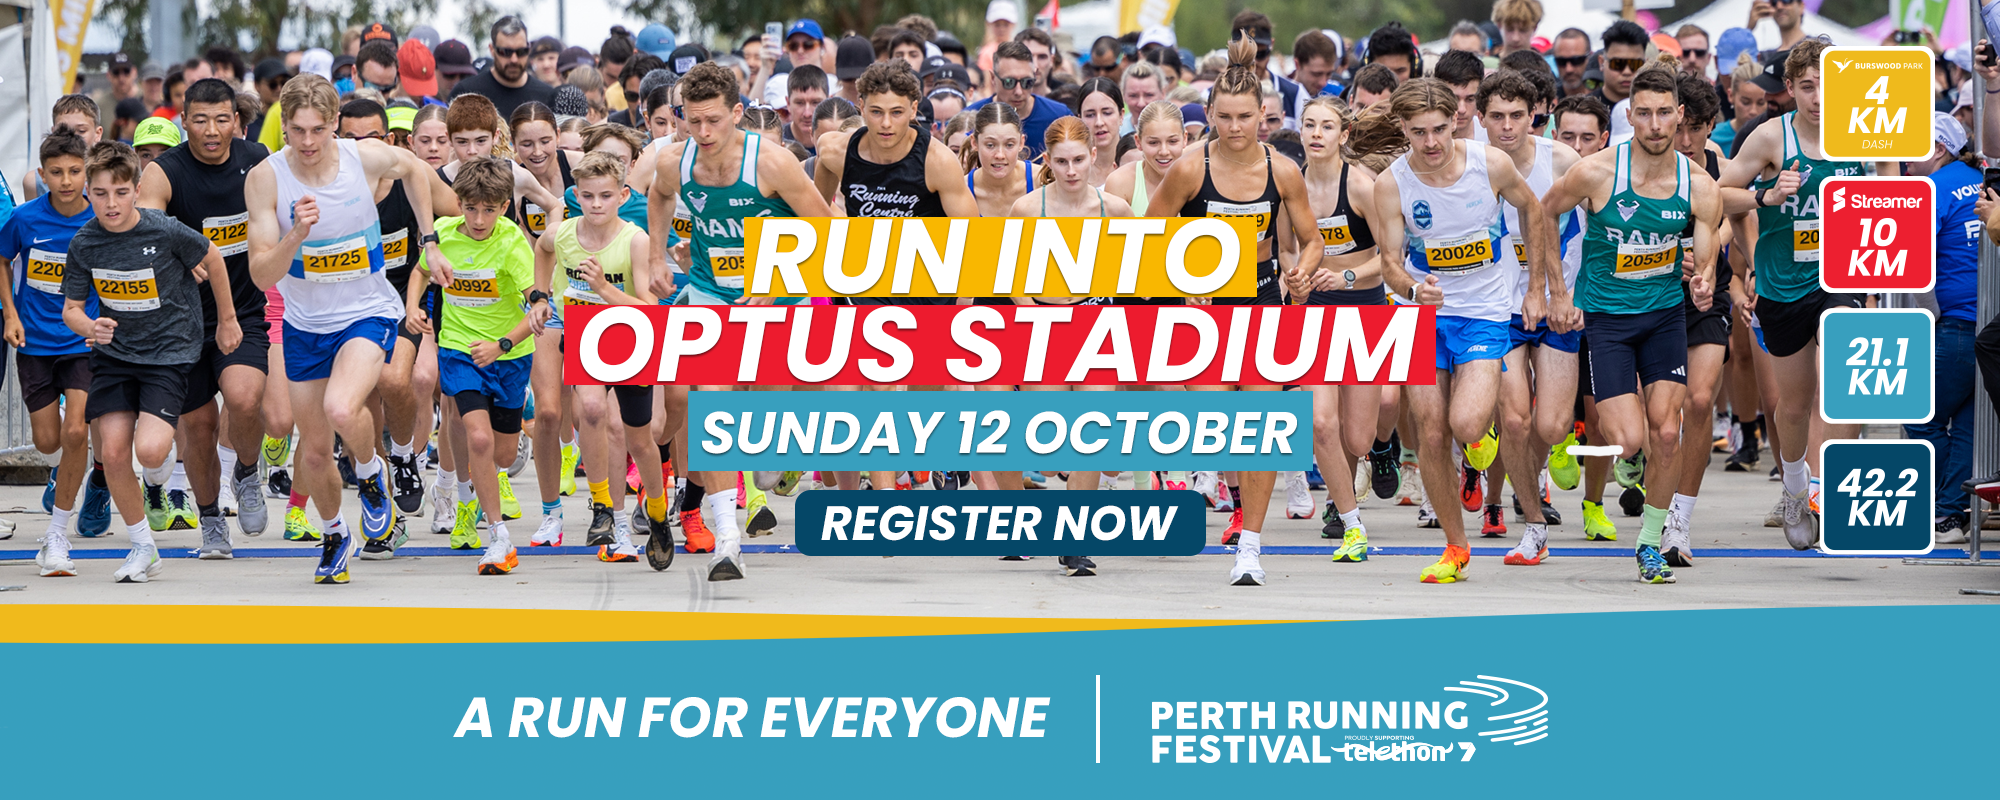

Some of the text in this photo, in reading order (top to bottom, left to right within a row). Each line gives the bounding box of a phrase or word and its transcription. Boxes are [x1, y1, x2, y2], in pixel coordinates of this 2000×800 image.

[729, 198, 755, 207] BIX
[849, 183, 920, 209] Running
[859, 201, 914, 217] Centre
[1661, 210, 1686, 220] BIX
[209, 222, 248, 241] 2122
[672, 218, 693, 233] 08
[309, 249, 361, 268] 21725
[1431, 241, 1486, 261] 20026
[1622, 249, 1671, 268] 20531
[100, 279, 150, 295] 22155
